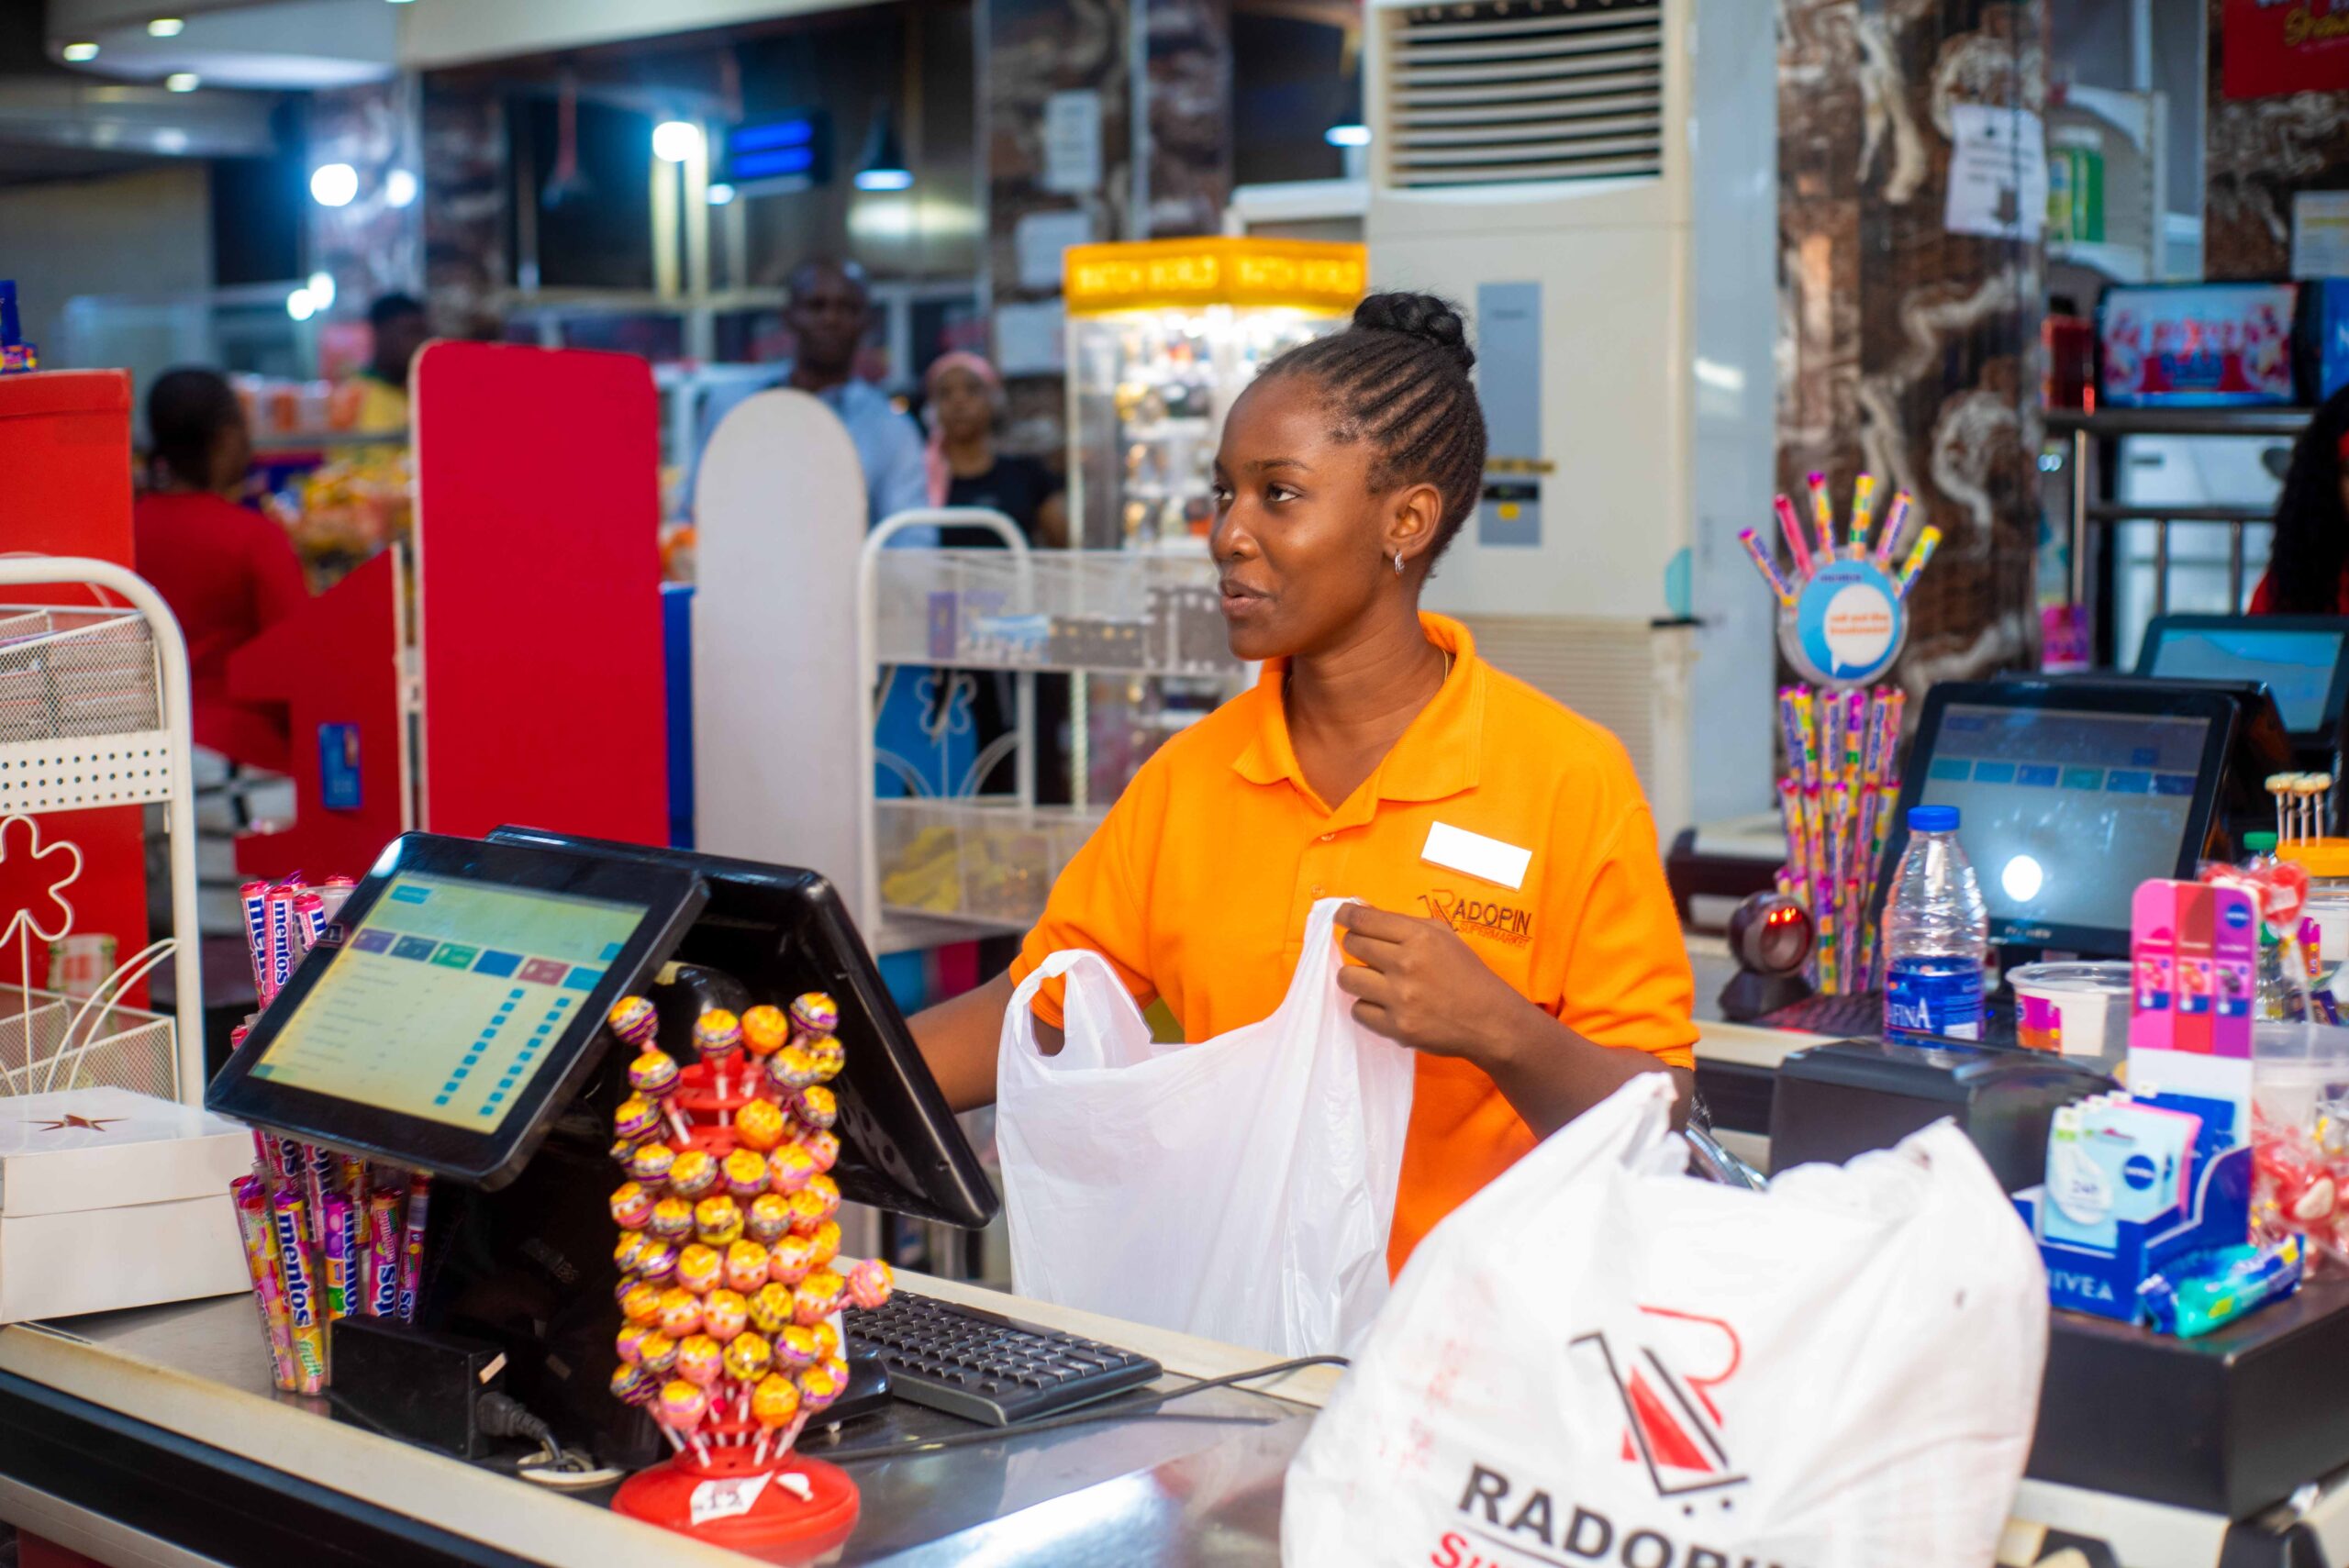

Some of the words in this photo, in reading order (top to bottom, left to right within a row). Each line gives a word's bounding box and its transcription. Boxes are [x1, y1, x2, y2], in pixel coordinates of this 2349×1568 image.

[1418, 889, 1531, 935] RADOPIN
[1459, 921, 1530, 949] SUPERMARKET
[274, 901, 291, 984] mentos
[1885, 998, 1931, 1029] FINA
[278, 1212, 310, 1328] mentos
[298, 1340, 323, 1376] fruit
[1458, 1462, 1785, 1568] RADO
